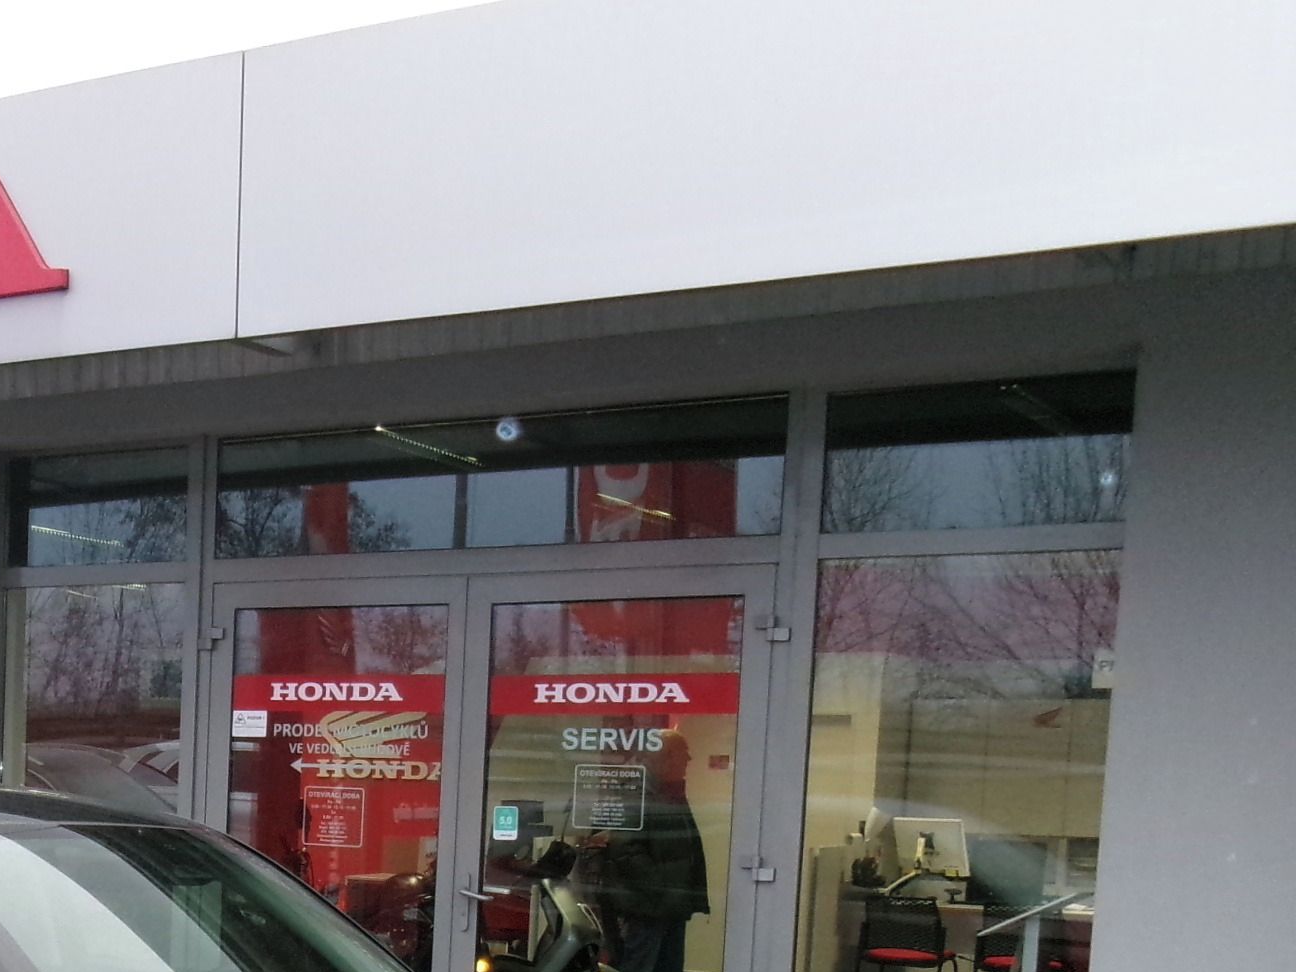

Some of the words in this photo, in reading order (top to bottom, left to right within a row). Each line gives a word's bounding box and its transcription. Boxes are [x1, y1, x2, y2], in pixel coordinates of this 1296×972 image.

[270, 682, 403, 701] HONDA
[534, 682, 690, 703] HONDA
[273, 722, 329, 738] PRODE
[561, 727, 664, 752] SERVIS
[289, 743, 303, 754] VE
